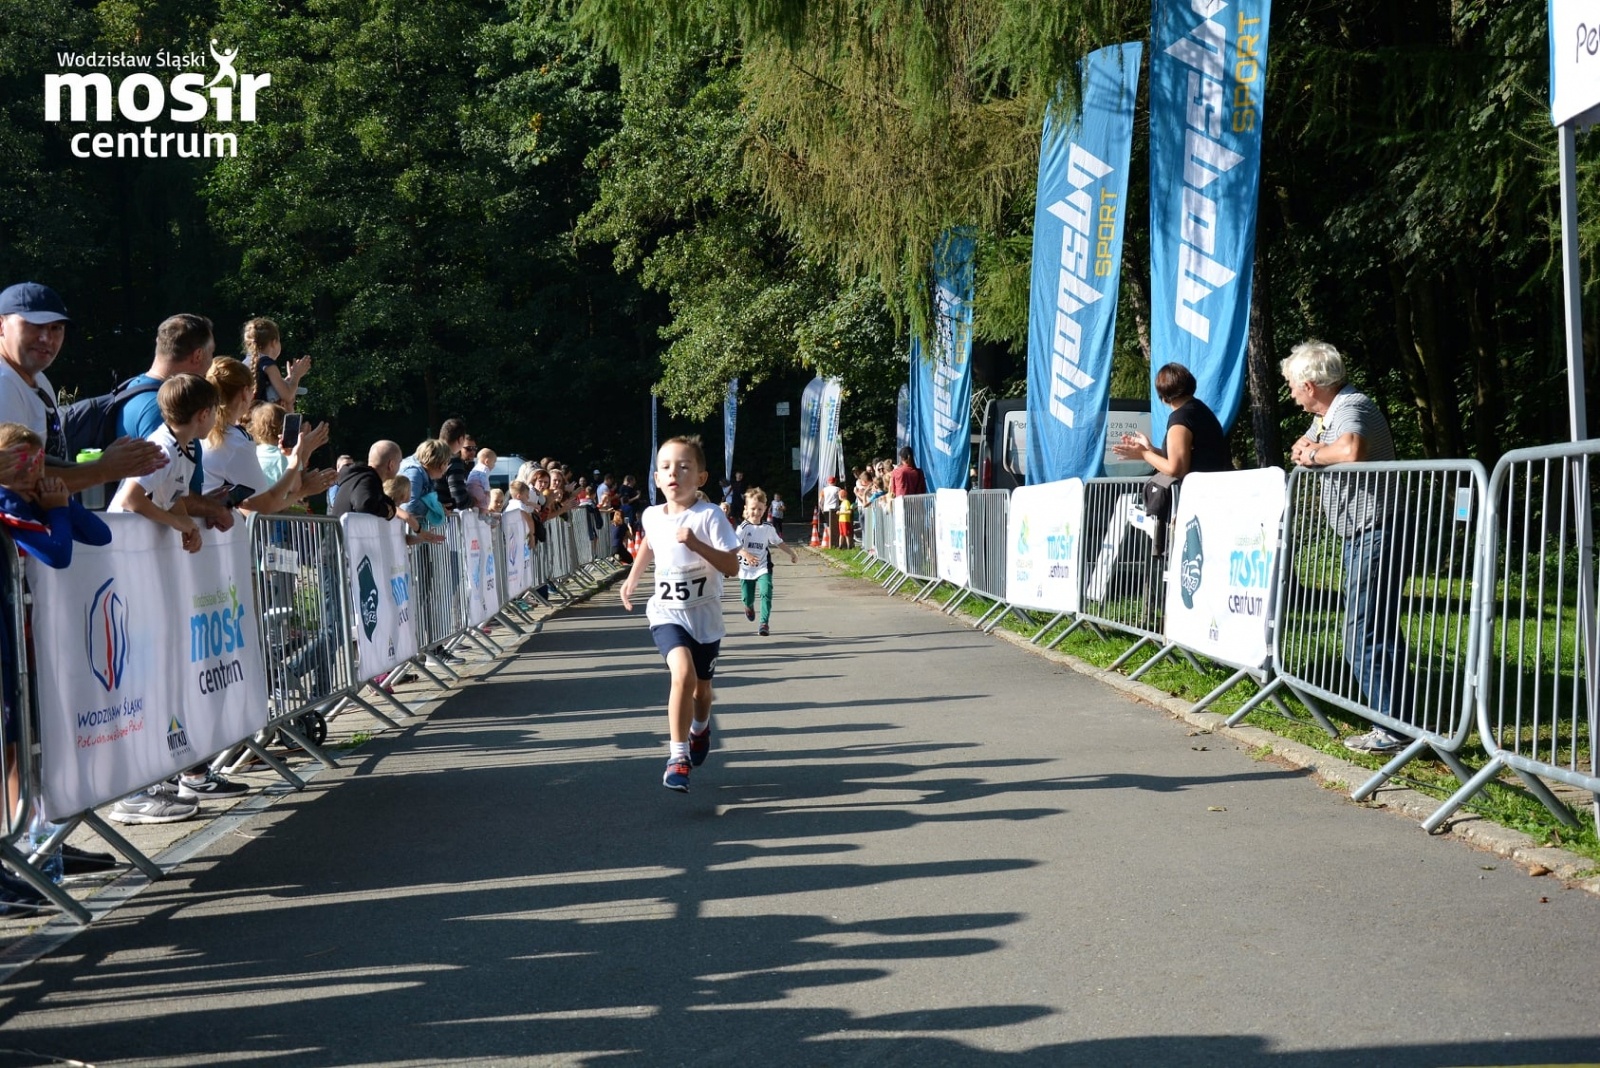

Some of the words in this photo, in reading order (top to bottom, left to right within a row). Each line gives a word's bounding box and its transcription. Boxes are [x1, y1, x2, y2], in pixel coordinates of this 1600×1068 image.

[1232, 11, 1261, 133] SPORT
[1576, 22, 1600, 64] Pe
[1094, 187, 1118, 277] SPORT
[659, 576, 707, 601] 257
